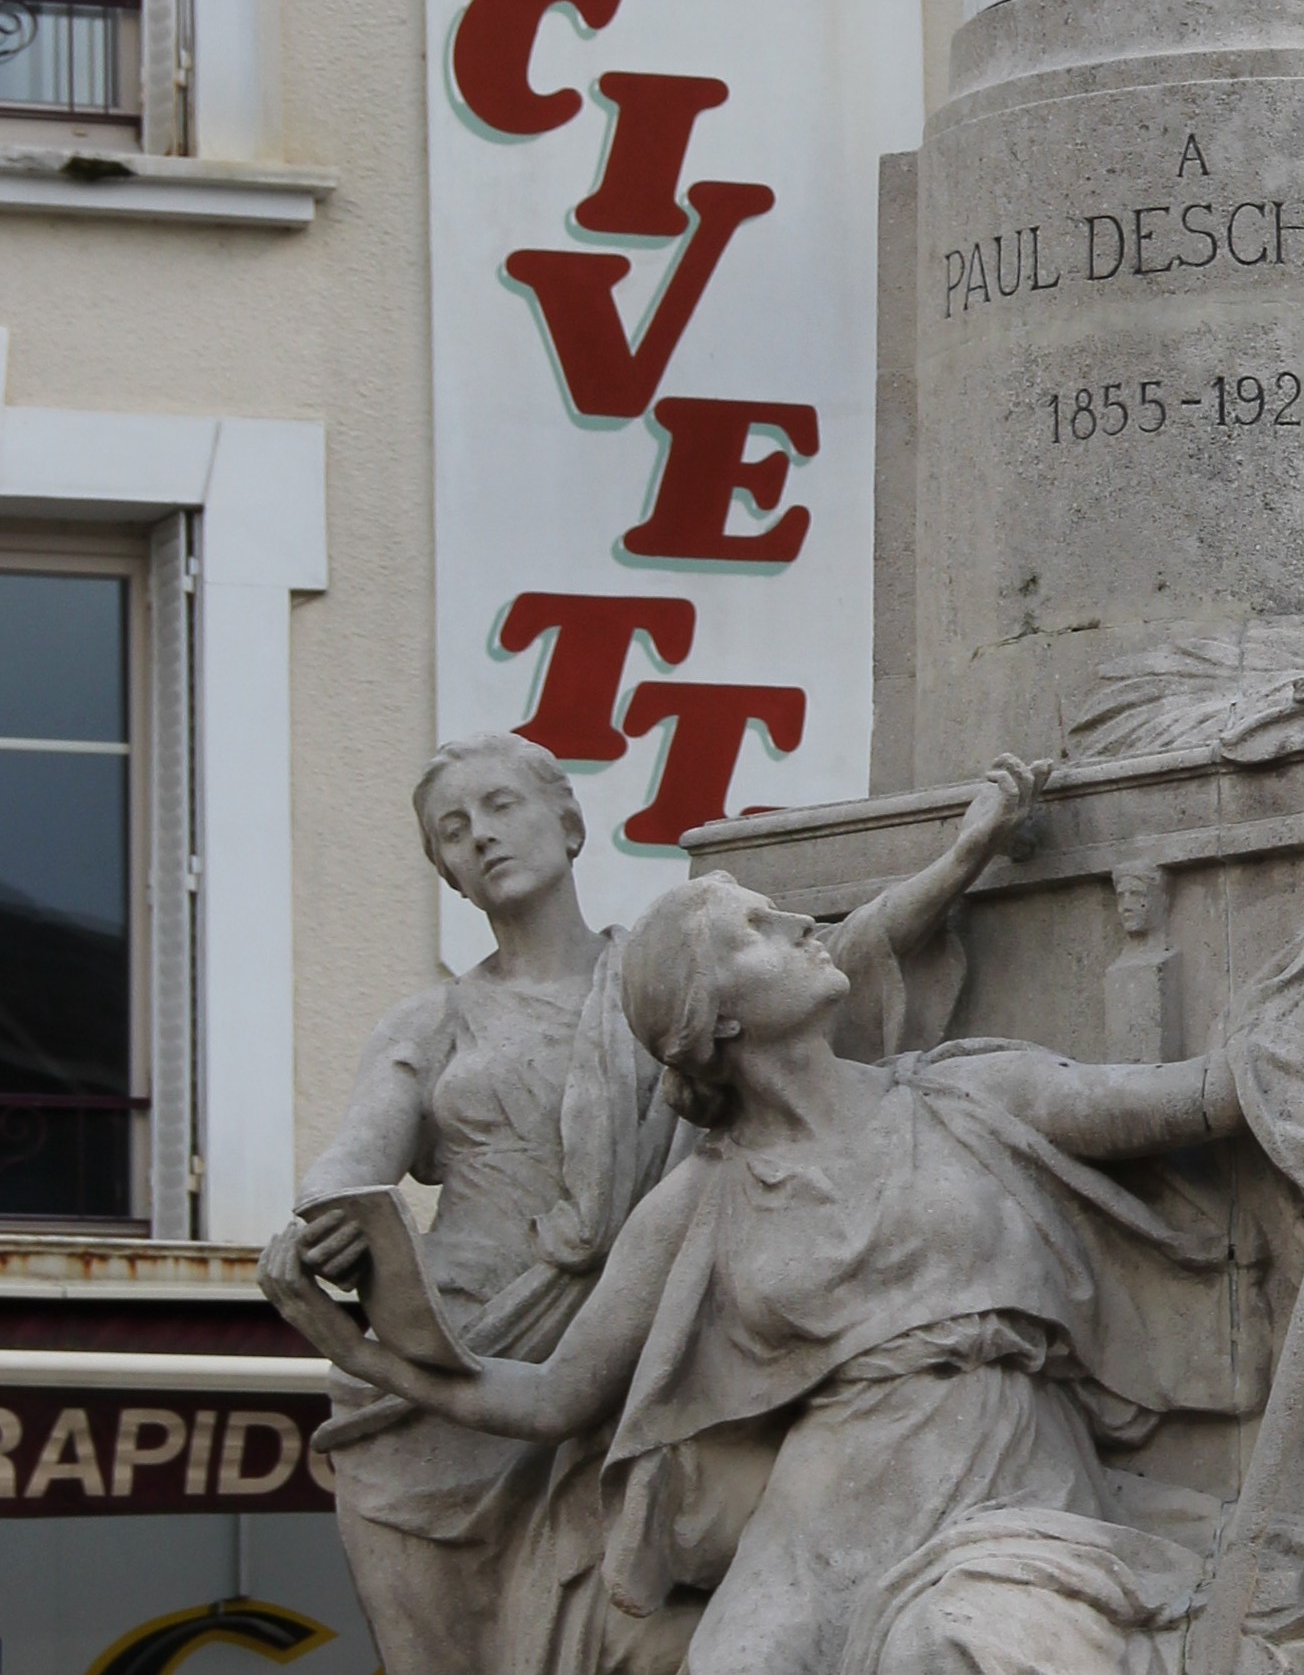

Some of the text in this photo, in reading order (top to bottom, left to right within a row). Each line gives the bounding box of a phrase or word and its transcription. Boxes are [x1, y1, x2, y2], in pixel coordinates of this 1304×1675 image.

[1177, 132, 1210, 178] A
[943, 226, 1060, 319] PAUL
[0, 1406, 337, 1498] APID
